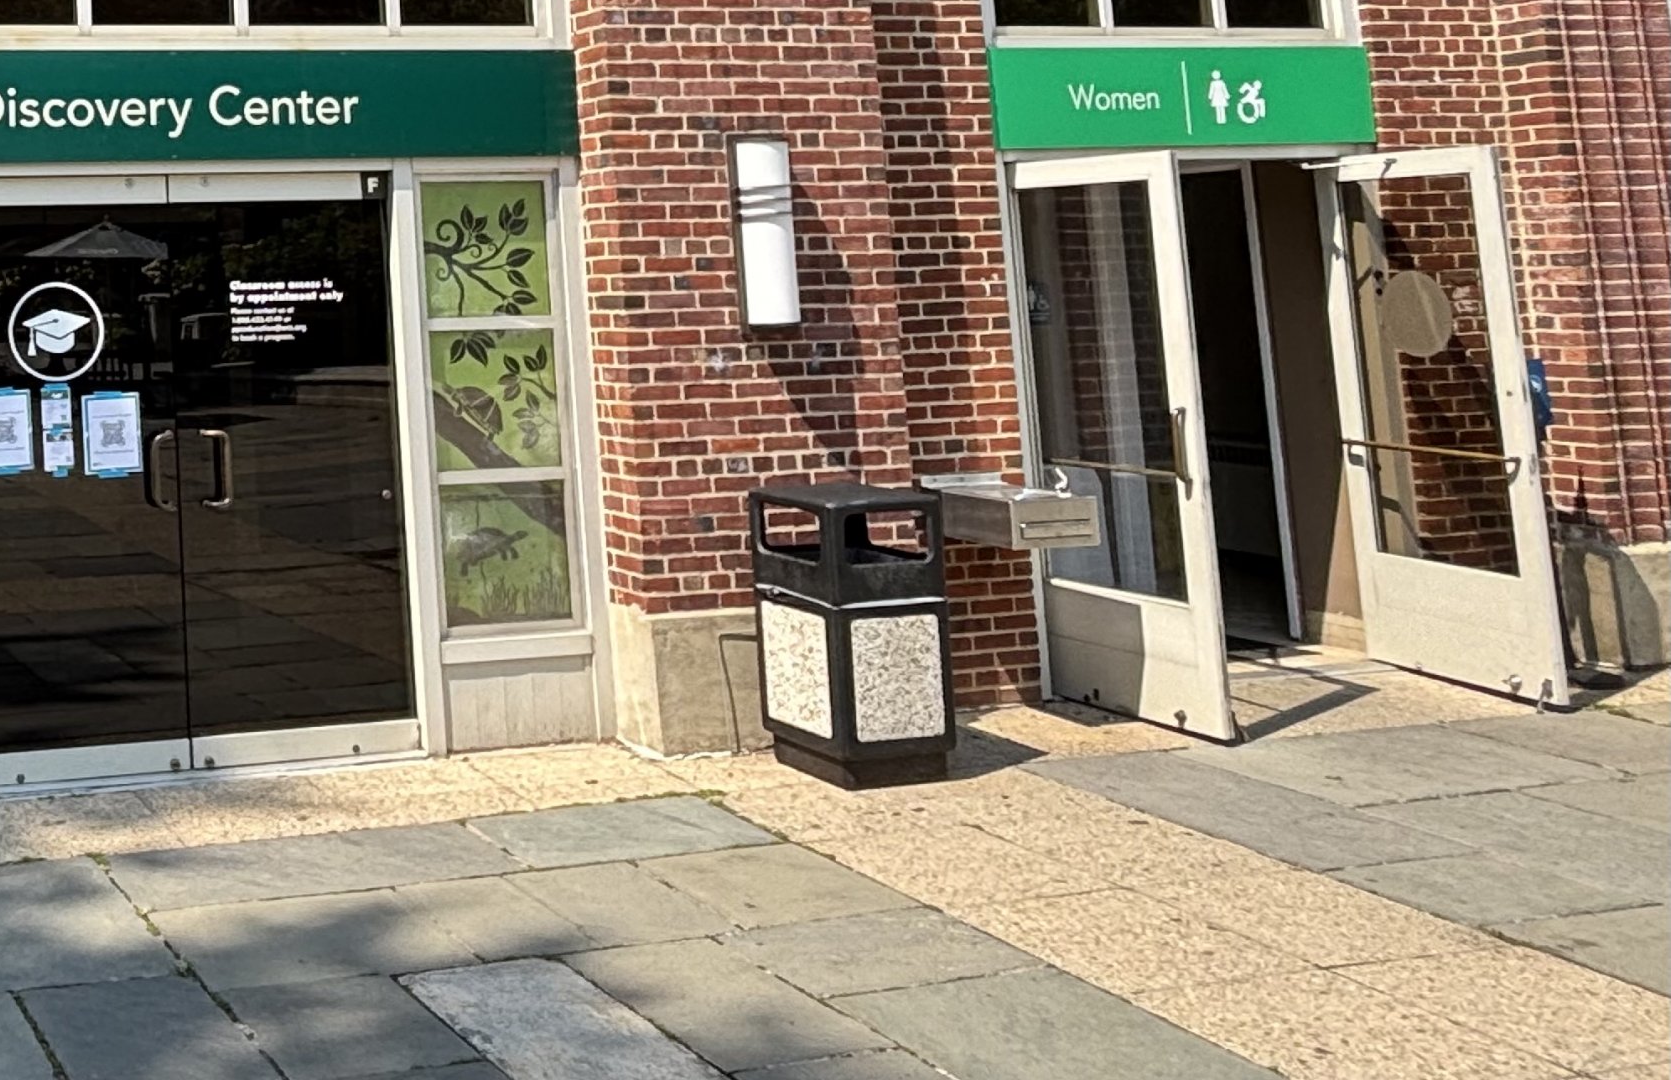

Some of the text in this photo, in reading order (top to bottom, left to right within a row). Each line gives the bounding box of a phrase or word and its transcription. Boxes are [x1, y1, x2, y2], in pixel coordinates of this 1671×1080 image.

[208, 85, 359, 126] Center
[1068, 84, 1160, 111] Women
[367, 177, 379, 193] F
[229, 277, 334, 291] Classroom access is
[229, 289, 344, 305] by appointment only
